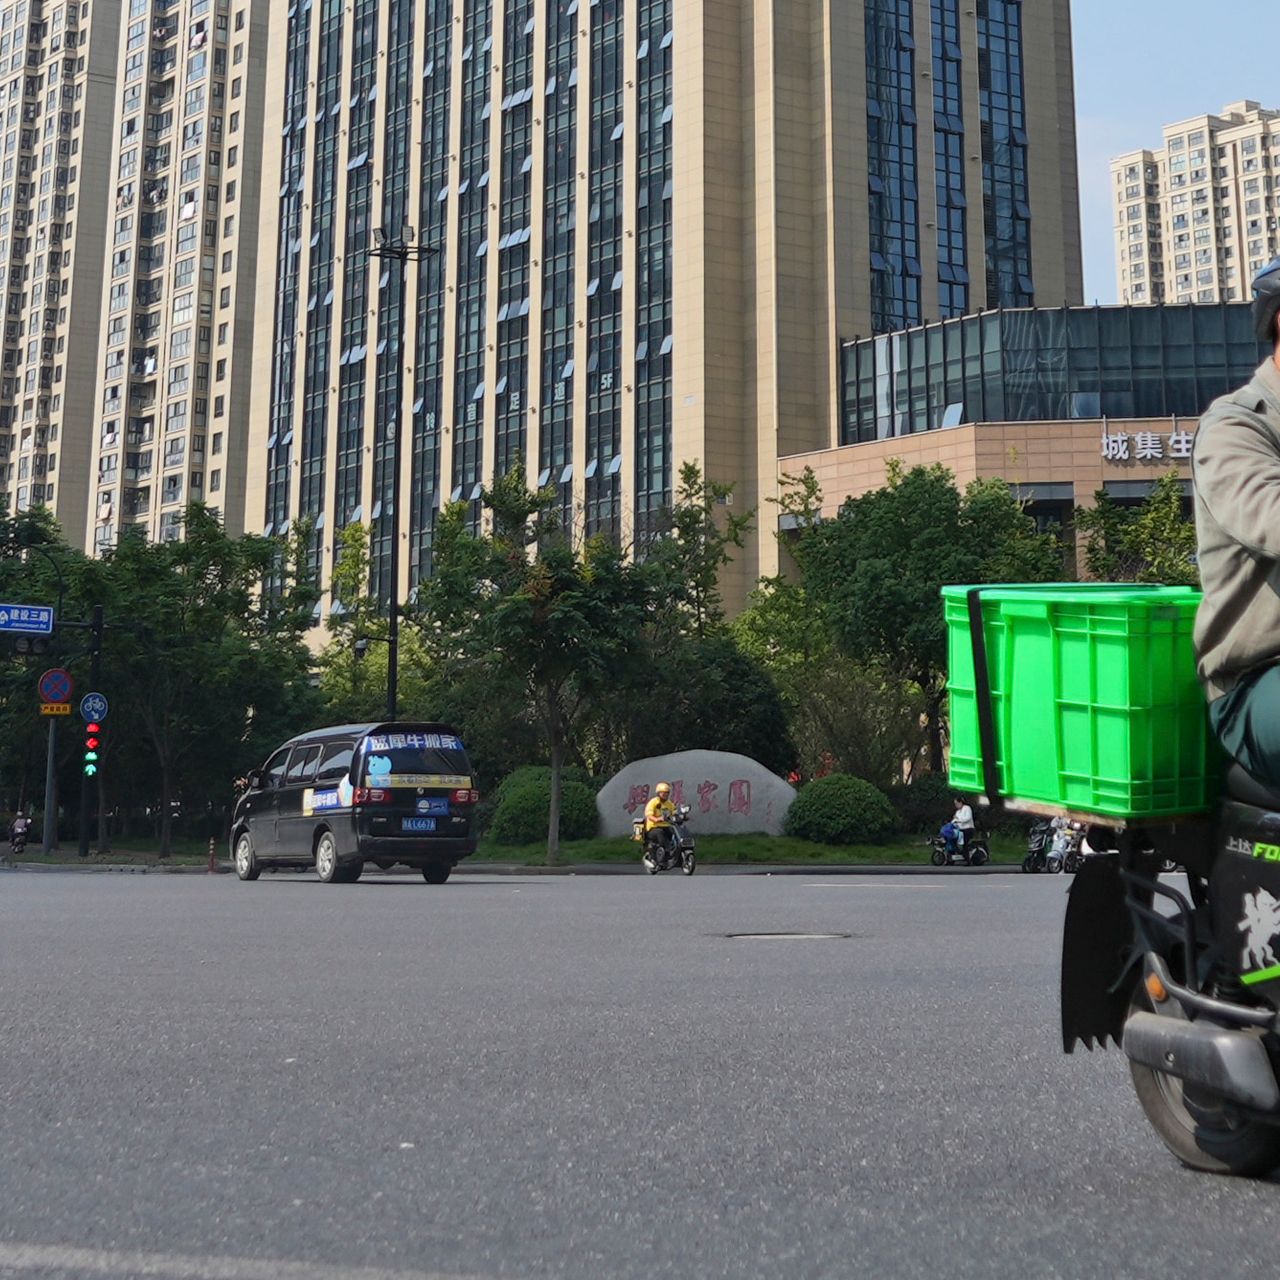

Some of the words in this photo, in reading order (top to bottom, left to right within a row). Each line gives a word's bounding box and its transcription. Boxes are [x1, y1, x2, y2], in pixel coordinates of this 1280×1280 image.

[1101, 430, 1194, 461] 城集生
[9, 608, 49, 623] 建设三路
[371, 733, 458, 750] 蓝犀牛搬家
